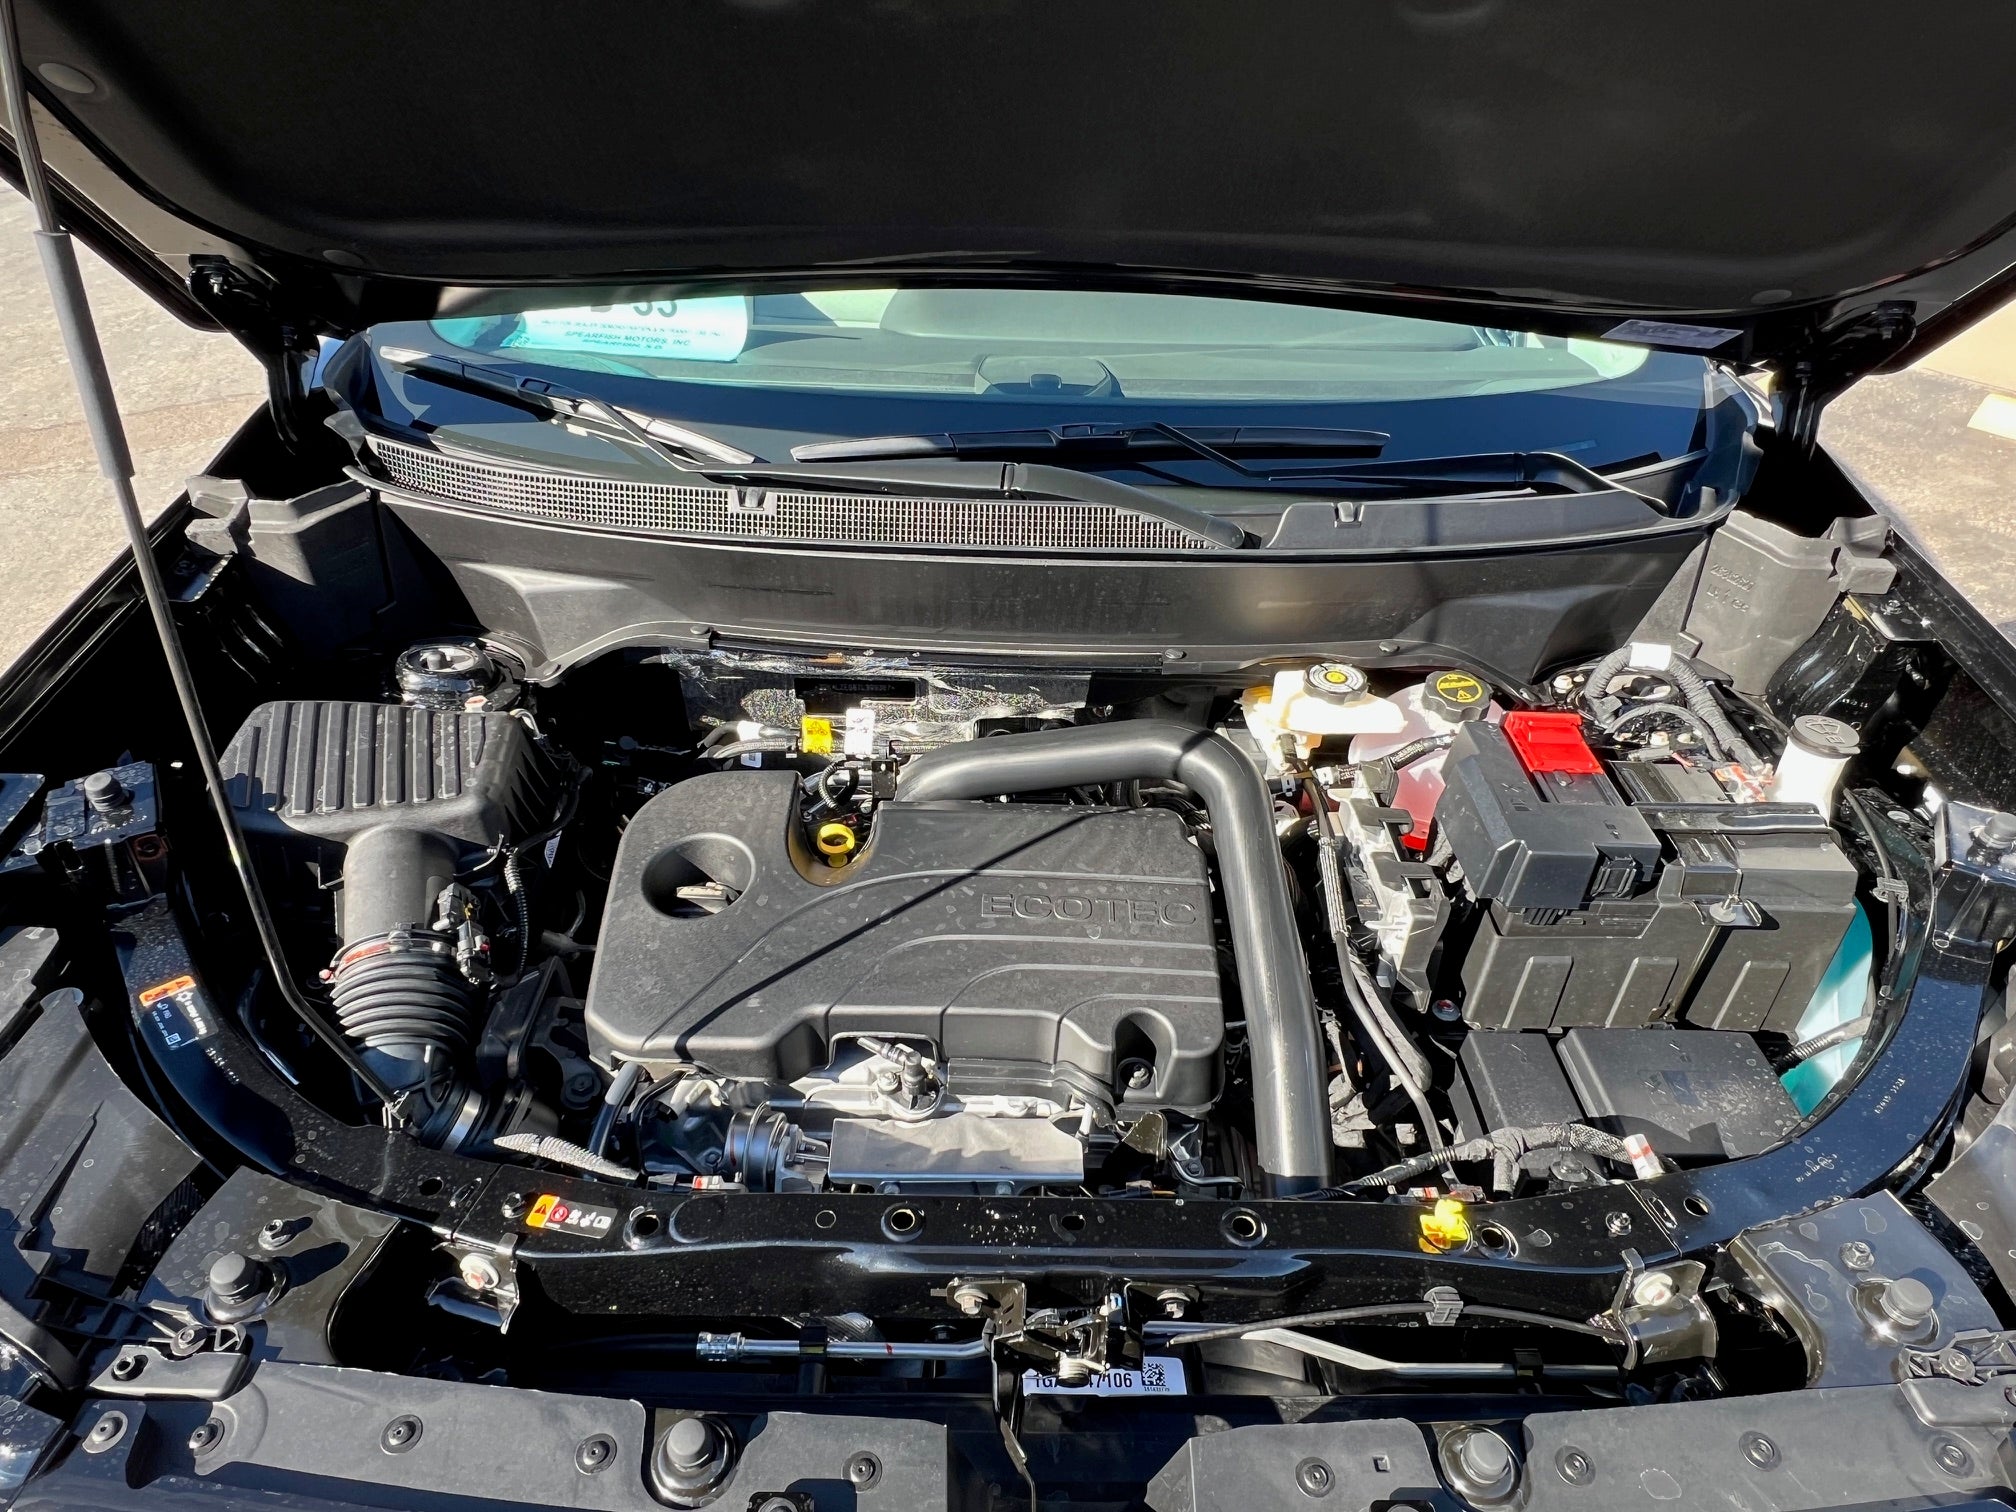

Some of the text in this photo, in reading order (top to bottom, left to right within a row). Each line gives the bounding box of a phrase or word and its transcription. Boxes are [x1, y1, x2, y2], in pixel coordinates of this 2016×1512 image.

[564, 331, 621, 340] SPEARFISH
[624, 335, 668, 345] MOTORS
[981, 893, 1197, 926] ECOTEC
